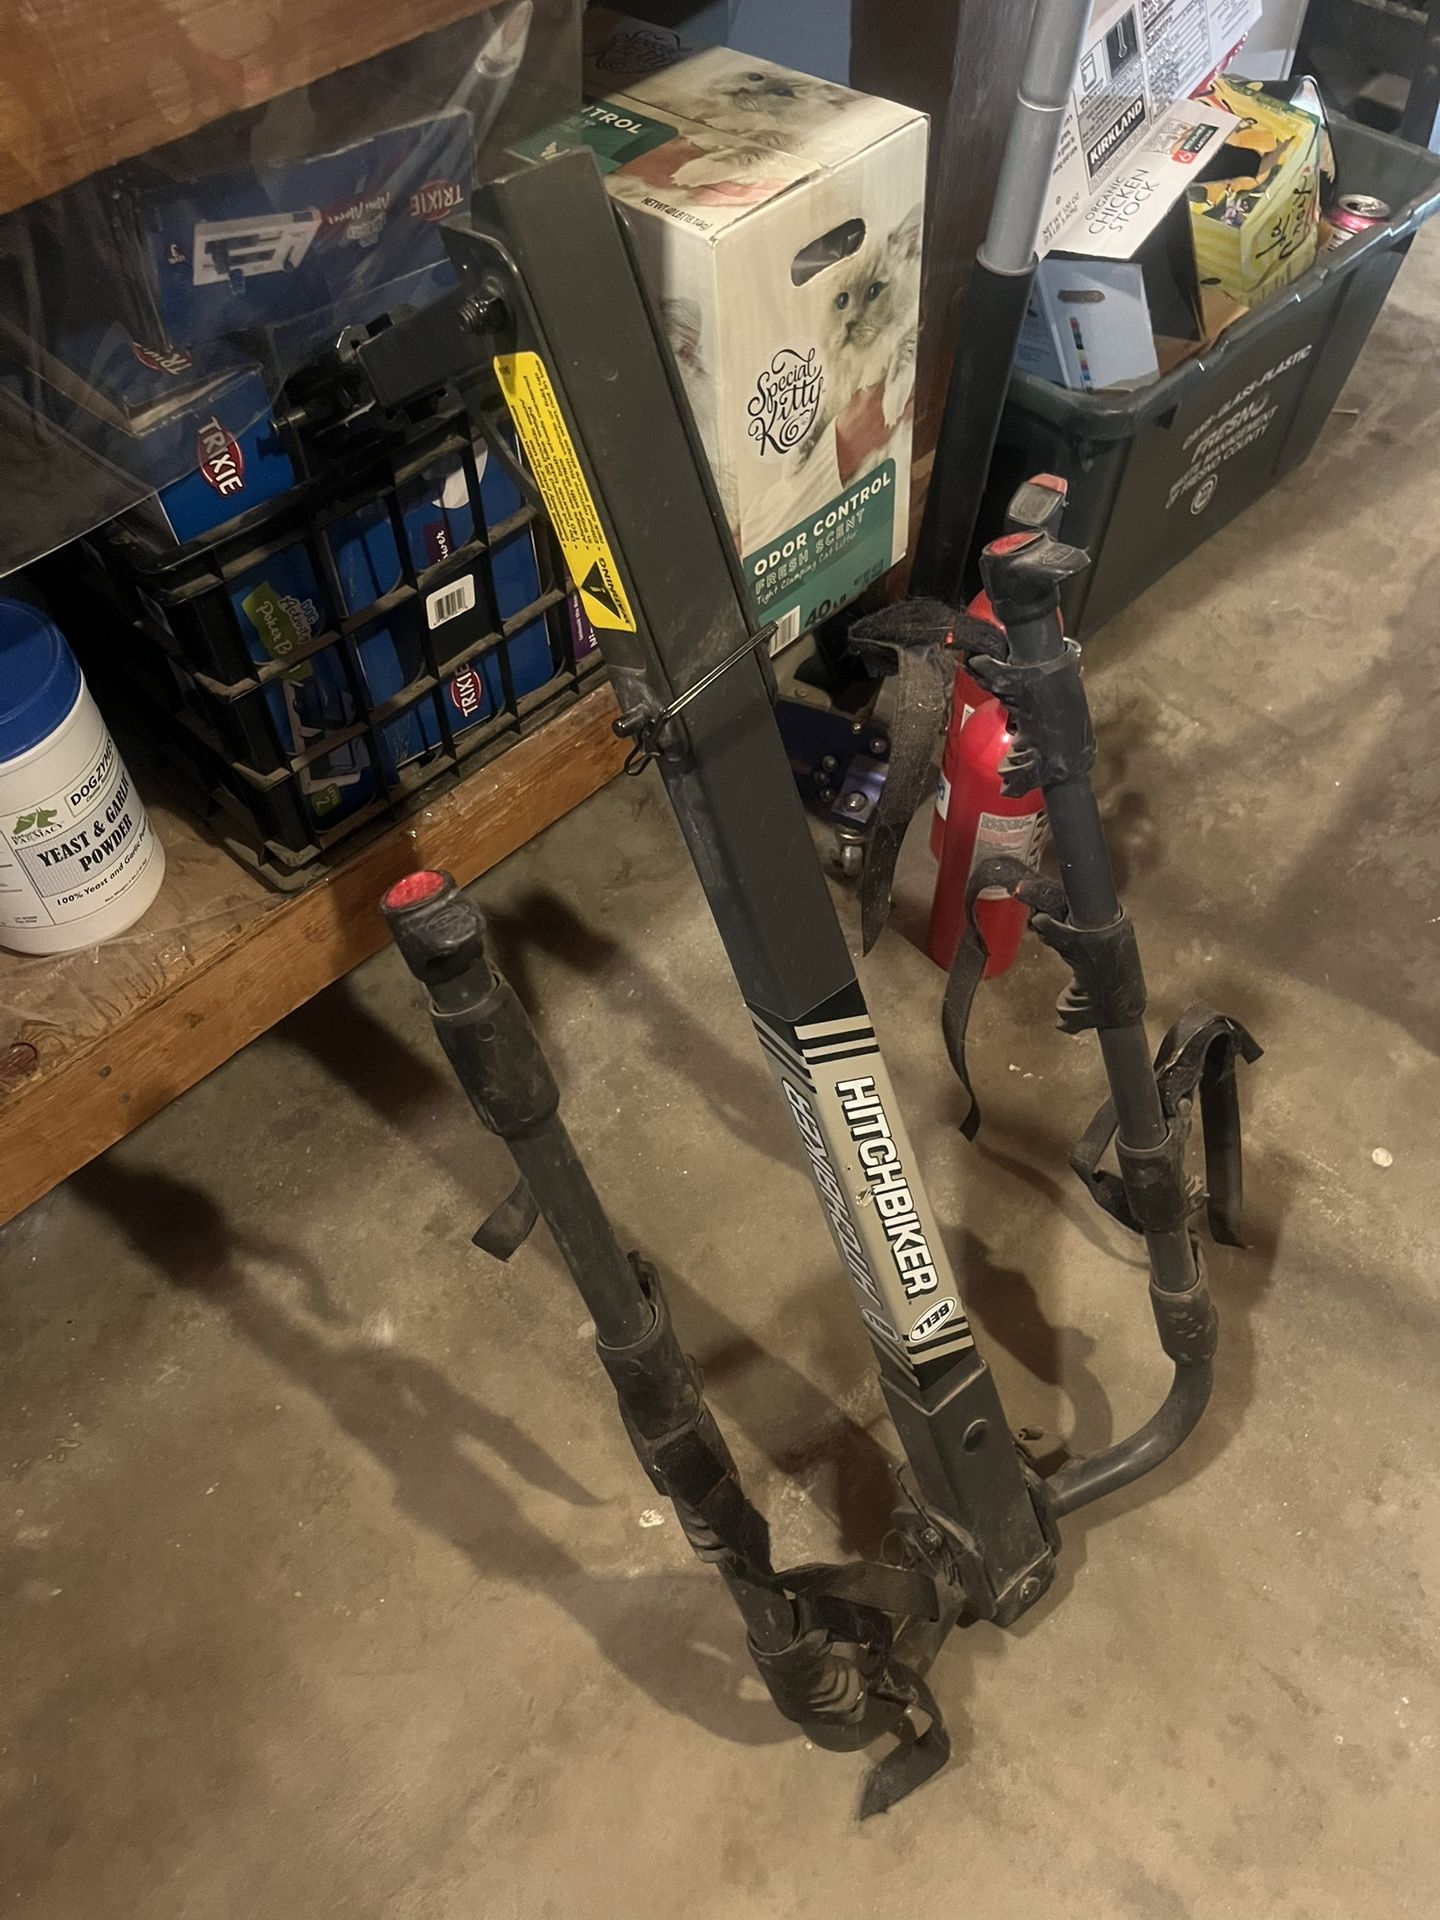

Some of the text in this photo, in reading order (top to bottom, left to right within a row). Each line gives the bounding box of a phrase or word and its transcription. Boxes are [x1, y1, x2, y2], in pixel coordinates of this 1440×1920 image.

[1089, 99, 1145, 165] KIRKLAND
[410, 184, 464, 217] TRIXIE
[1084, 175, 1127, 220] ORGANIC
[1088, 168, 1150, 235] CHICKEN
[1109, 179, 1160, 233] STOCK
[748, 347, 816, 417] Special
[748, 365, 824, 456] Kitty
[526, 406, 543, 437] weight
[198, 416, 243, 495] TRIXIE
[547, 463, 560, 483] total
[556, 486, 573, 520] pounds
[569, 490, 580, 508] with
[572, 511, 588, 542] Always
[754, 531, 808, 576] ODOR
[813, 472, 892, 537] CONTROL
[755, 549, 809, 595] FRESH
[815, 508, 865, 554] SCENT
[756, 530, 858, 606] Tight Clumping Cat Litter
[599, 557, 630, 624] WARNING
[804, 598, 832, 628] 40
[256, 600, 282, 642] Poker
[454, 662, 480, 718] TRIXIE
[37, 830, 91, 867] YEAST
[93, 820, 106, 837] &
[78, 813, 134, 873] POWDER
[57, 892, 84, 906] 100%
[83, 877, 108, 895] Yeast
[109, 862, 124, 880] and
[124, 840, 142, 865] Garlic
[782, 1077, 884, 1310] HITCHBIKER
[835, 1076, 940, 1300] HITCHBIKER
[914, 1302, 950, 1335] BELL
